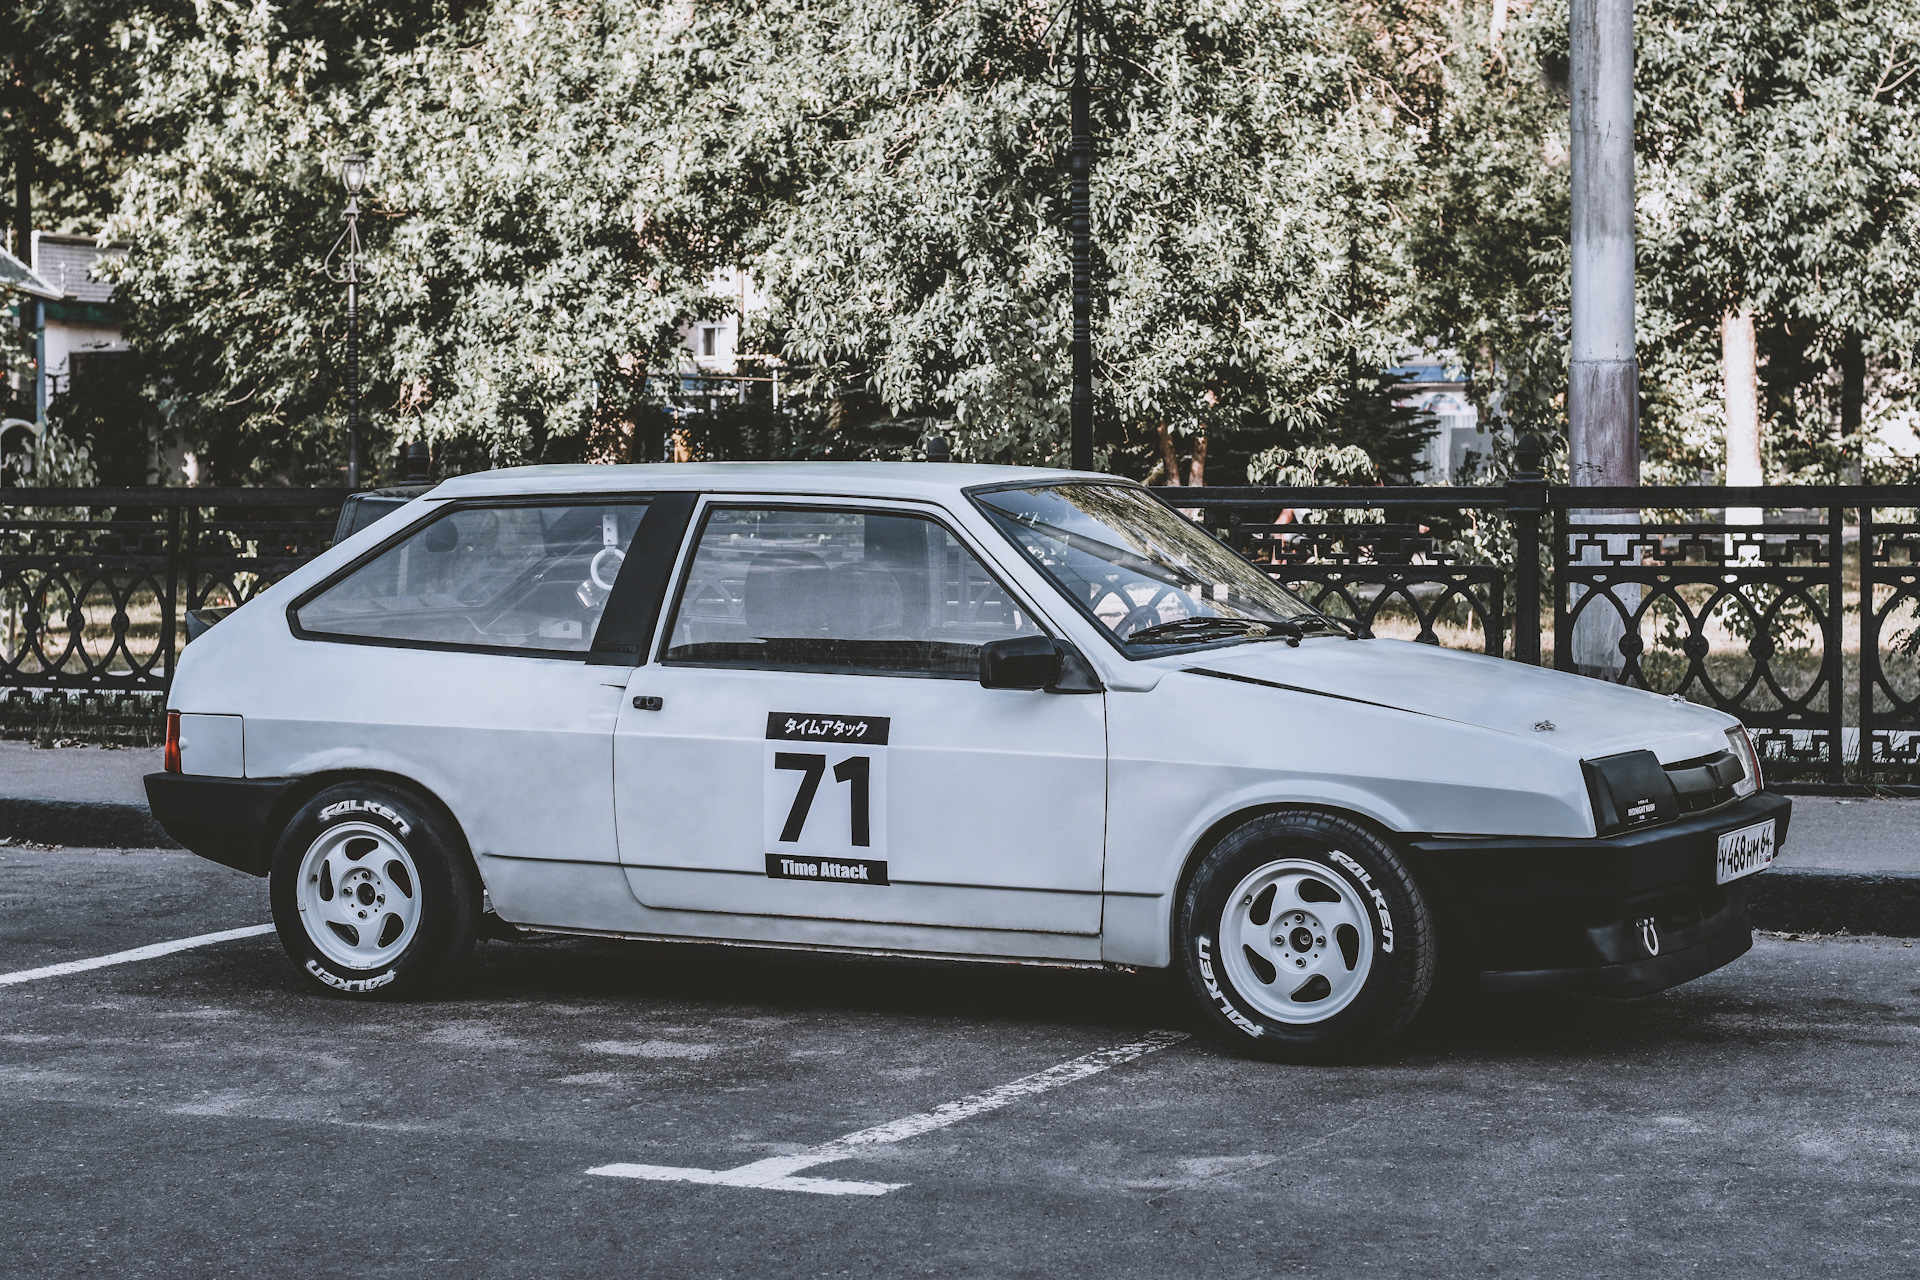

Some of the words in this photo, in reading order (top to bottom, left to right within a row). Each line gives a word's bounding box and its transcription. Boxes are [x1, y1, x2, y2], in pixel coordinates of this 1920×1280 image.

[784, 717, 869, 738] タイムアタック
[318, 799, 412, 839] FALKEN
[774, 751, 871, 848] 71
[780, 858, 818, 877] Time
[820, 861, 869, 881] Attack
[1329, 849, 1394, 954] FALKEN
[304, 959, 397, 992] FALKEN
[1196, 935, 1264, 1038] FALKEN
